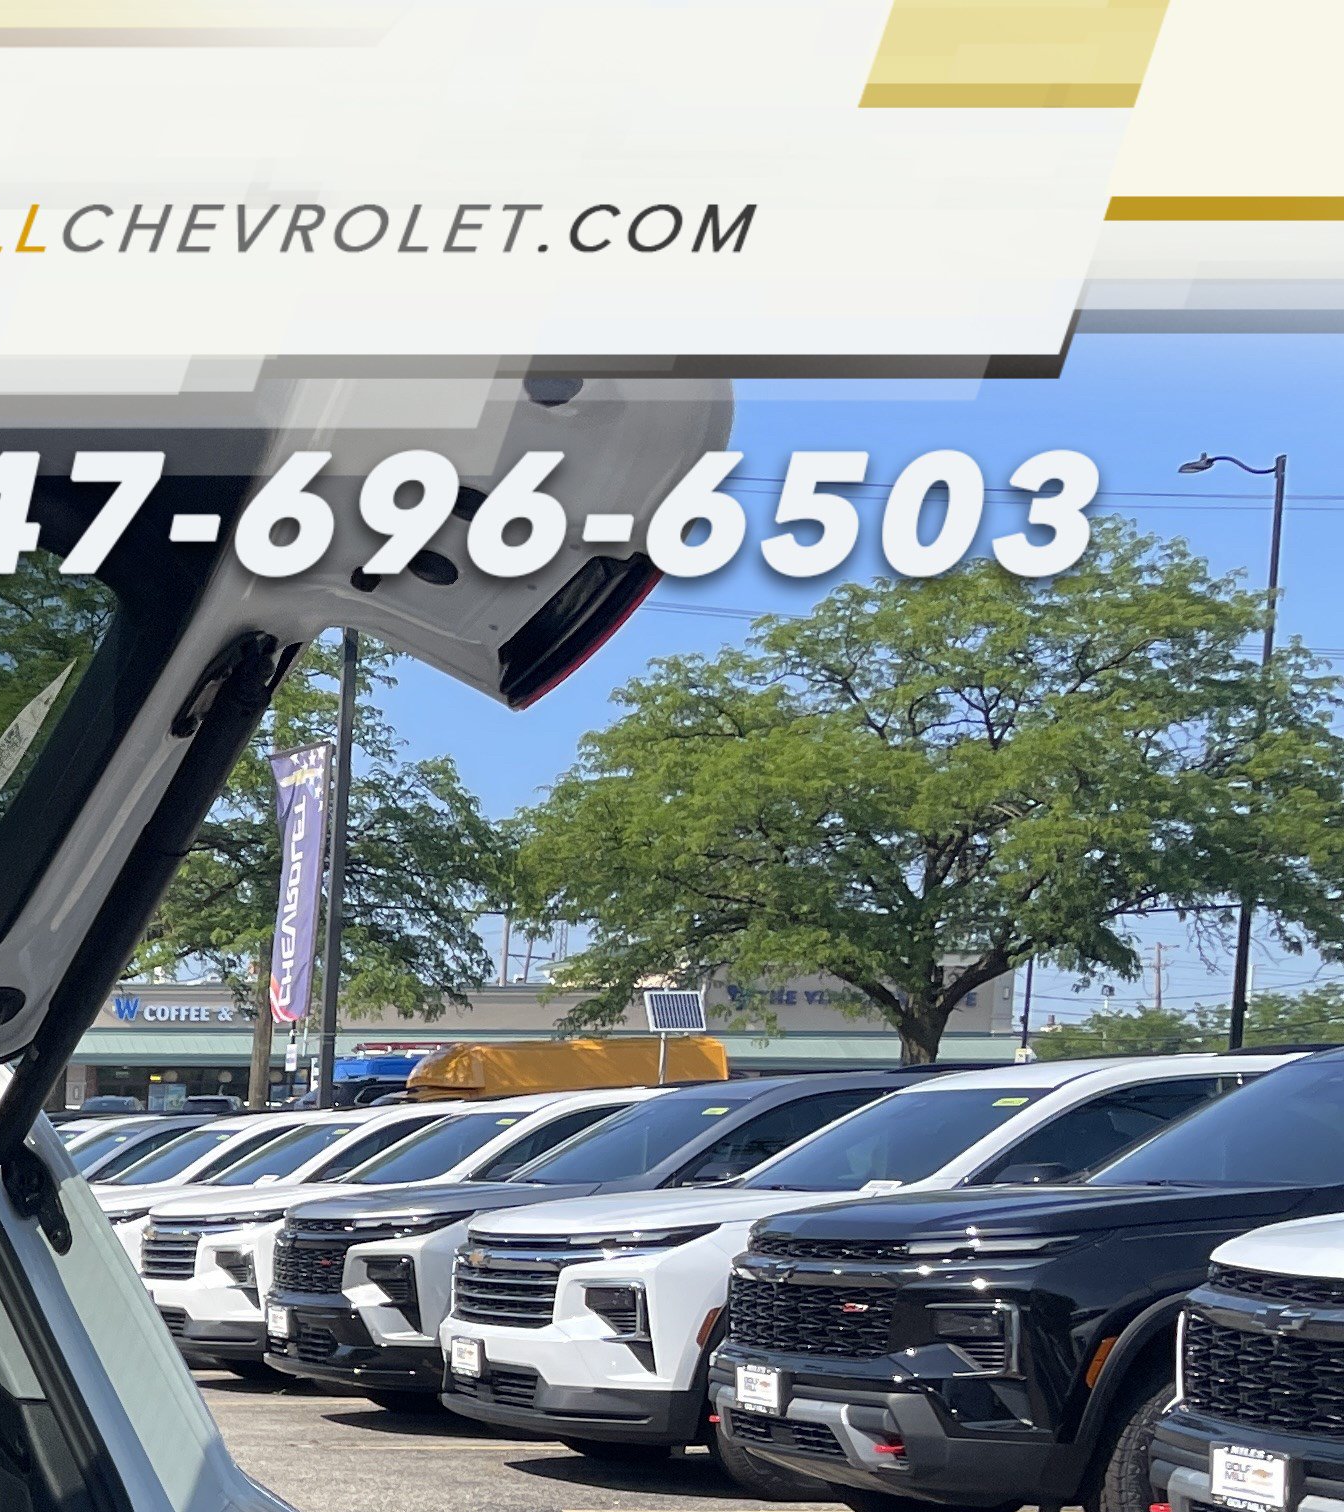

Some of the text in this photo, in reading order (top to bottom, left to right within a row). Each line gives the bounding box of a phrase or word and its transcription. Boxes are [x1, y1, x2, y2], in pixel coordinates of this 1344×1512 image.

[277, 794, 307, 1007] CHEVROLET
[115, 996, 140, 1021] W
[143, 1005, 210, 1022] COFFEE
[217, 1006, 234, 1022] &
[1225, 1461, 1252, 1474] GOLF
